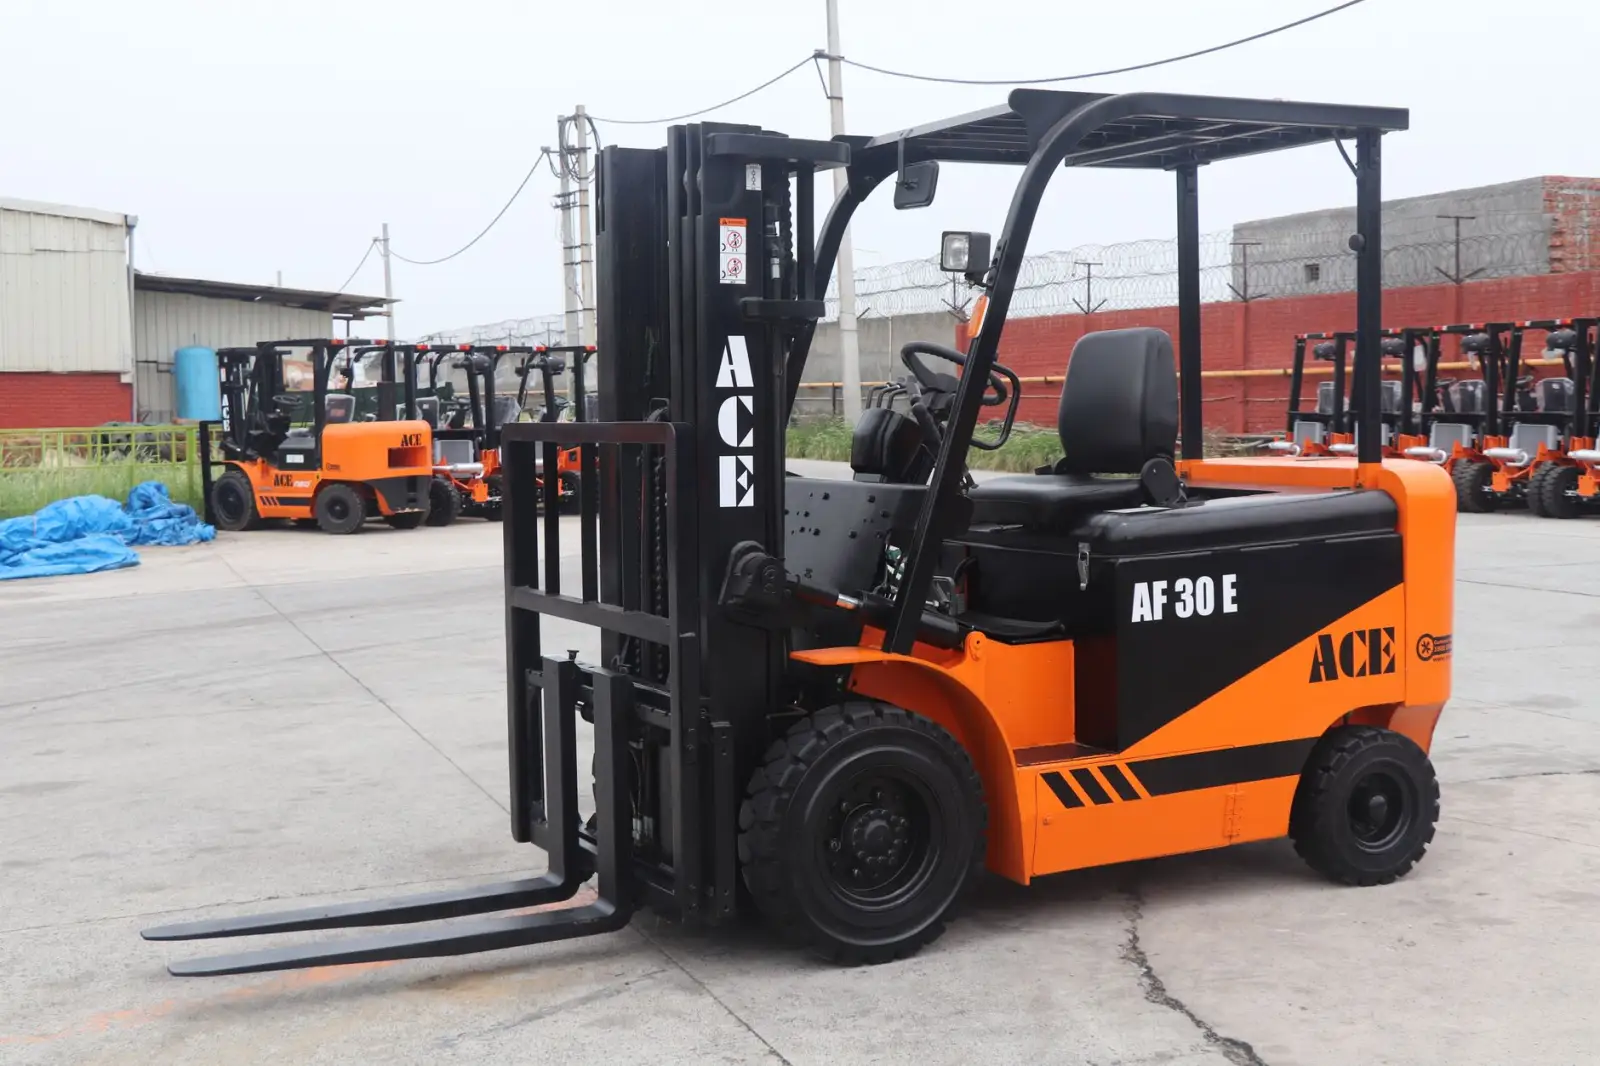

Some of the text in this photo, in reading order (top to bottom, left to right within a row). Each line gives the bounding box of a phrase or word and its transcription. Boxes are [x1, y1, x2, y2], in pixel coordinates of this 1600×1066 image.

[400, 433, 422, 447] ACE
[715, 335, 755, 508] ACE
[273, 473, 293, 487] ACE
[1131, 573, 1238, 623] AF 30 E
[1308, 626, 1396, 684] ACE
